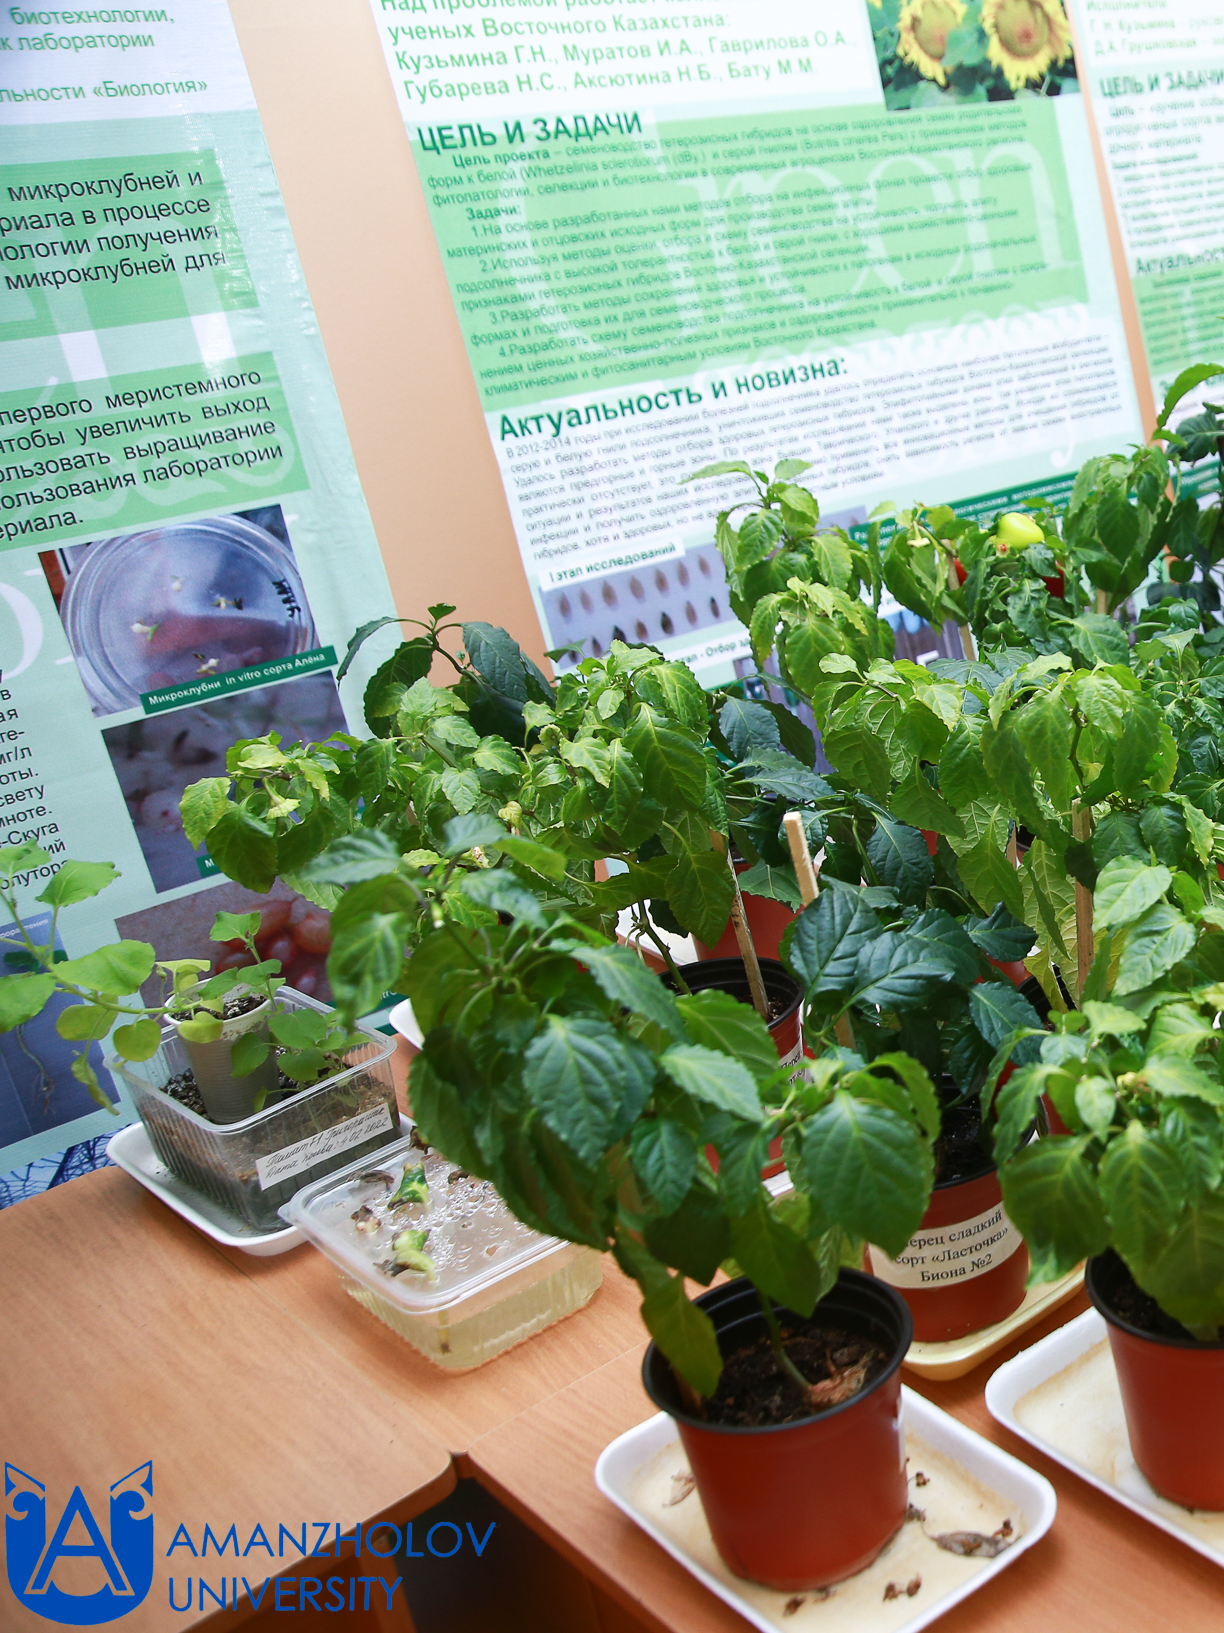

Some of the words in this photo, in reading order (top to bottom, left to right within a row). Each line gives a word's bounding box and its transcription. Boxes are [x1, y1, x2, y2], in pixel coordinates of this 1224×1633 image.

[10, 7, 175, 26] биотехнологии,
[387, 22, 476, 46] ученых
[482, 16, 607, 37] Восточного
[613, 14, 731, 32] Казахстана:
[18, 32, 155, 52] лаборатории
[395, 50, 508, 75] Кузьмина
[514, 44, 559, 64] Г.Н.,
[562, 43, 652, 66] Муратов
[657, 38, 703, 57] И.А.,
[708, 35, 810, 55] Гаврилова
[93, 79, 208, 98] «Биология»
[404, 78, 510, 105] Губарева
[516, 72, 568, 93] Н.С.,
[573, 70, 672, 90] Аксютина
[677, 63, 723, 83] Н.Б.,
[727, 60, 771, 81] Бату
[417, 122, 497, 156] ЦЕЛЬ
[503, 118, 525, 144] И
[532, 111, 642, 142] ЗАДАЧИ
[452, 153, 491, 169] Цель
[494, 148, 551, 166] проекта
[7, 170, 181, 203] микроклубней
[189, 171, 204, 186] и
[427, 174, 464, 190] форм
[476, 168, 517, 183] белой
[0, 211, 76, 237] риала
[82, 209, 97, 225] в
[103, 197, 211, 227] процессе
[465, 204, 521, 221] Задачи:
[505, 218, 549, 232] основе
[97, 224, 219, 252] получения
[446, 239, 529, 258] материнских
[5, 255, 176, 291] микроклубней
[184, 251, 227, 273] для
[456, 271, 551, 294] подсолнечника
[461, 292, 536, 313] признаками
[471, 329, 519, 348] формах
[480, 363, 523, 379] нением
[526, 354, 576, 373] ценных
[0, 399, 93, 426] первого
[105, 371, 262, 410] меристемного
[484, 371, 578, 397] климатическим
[500, 386, 703, 441] Актуальность
[711, 381, 728, 399] и
[735, 357, 848, 394] новизна:
[75, 411, 191, 446] увеличить
[202, 396, 270, 420] выход
[123, 419, 276, 461] выращивание
[515, 436, 572, 457] 2012-2014
[0, 472, 136, 511] ользования
[143, 444, 284, 485] лаборатории
[556, 566, 583, 582] этап
[585, 541, 677, 574] исследований
[148, 681, 221, 706] Микроклубни
[225, 676, 237, 686] in
[237, 670, 262, 683] vitro
[263, 662, 293, 678] сорта
[294, 653, 326, 668] Алёна
[907, 1234, 946, 1250] ерец
[949, 1209, 1003, 1242] сладкий
[931, 1227, 1009, 1263] «Ласточка»
[920, 1264, 967, 1283] Биона
[970, 1253, 993, 1273] №2
